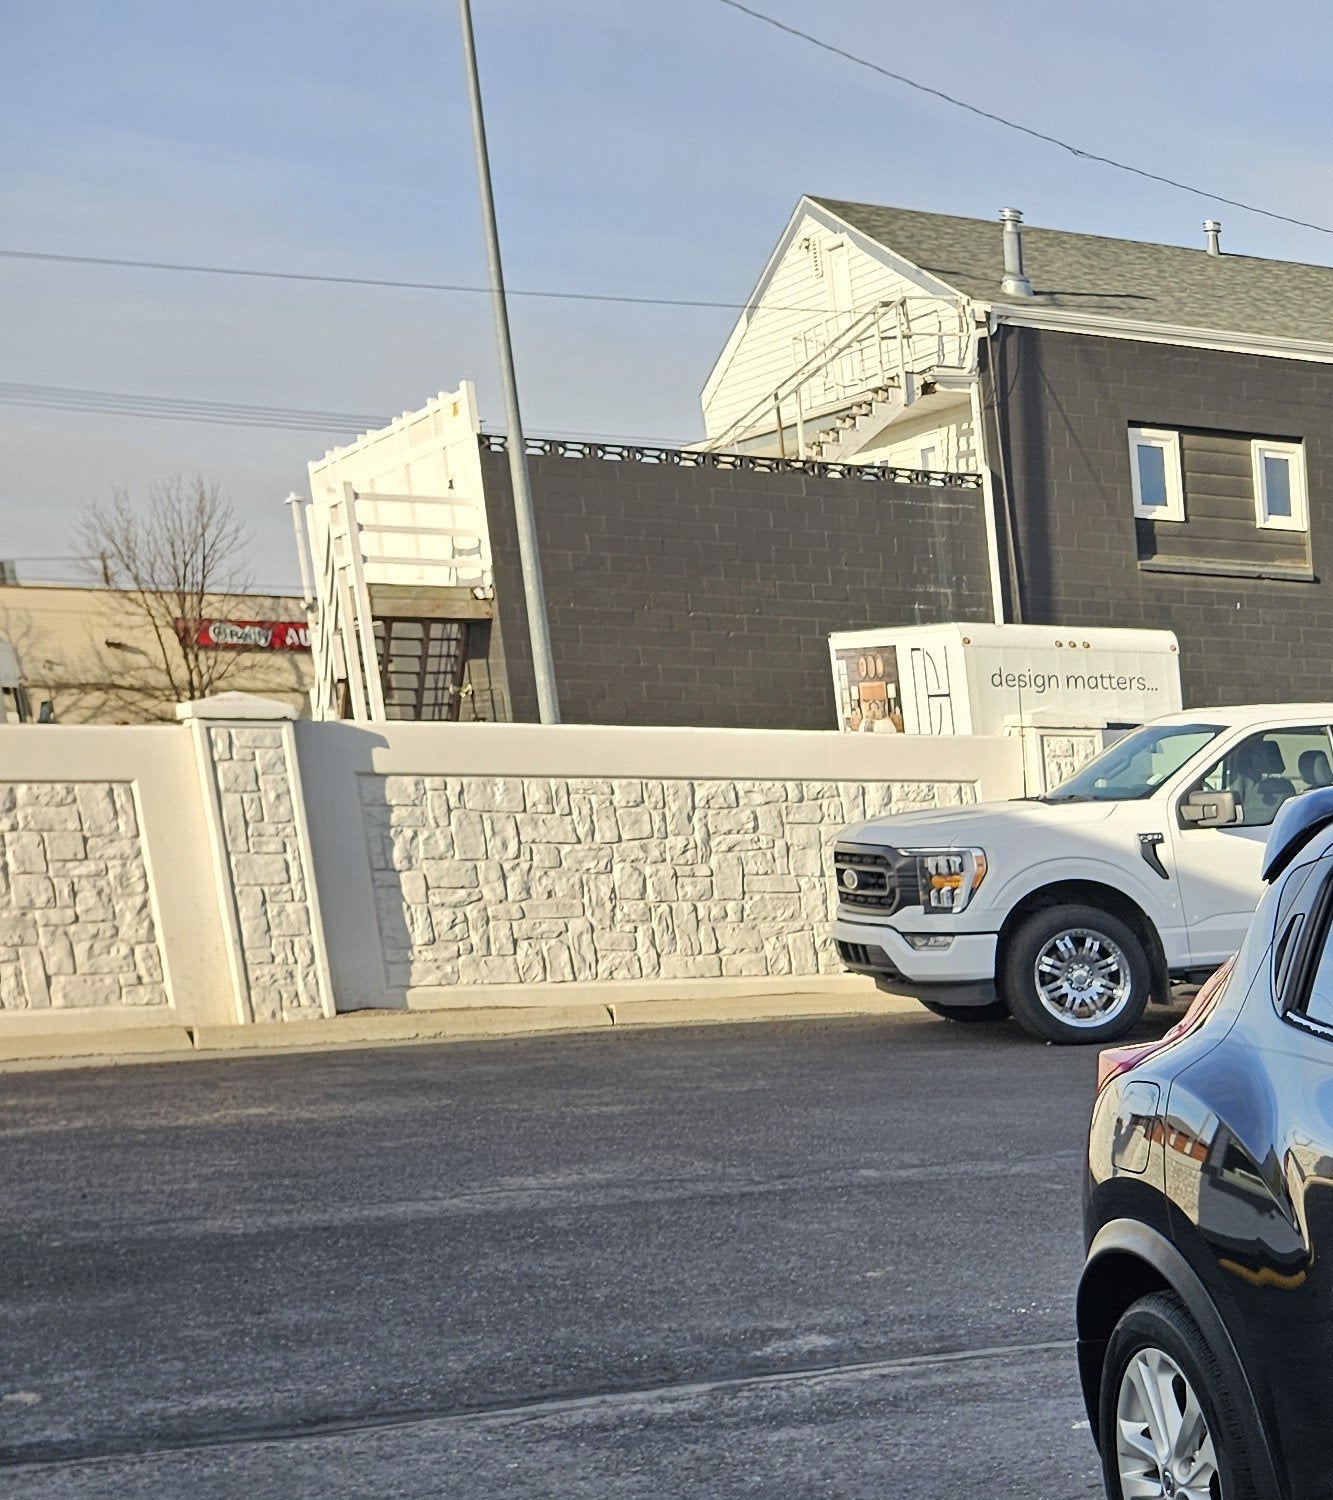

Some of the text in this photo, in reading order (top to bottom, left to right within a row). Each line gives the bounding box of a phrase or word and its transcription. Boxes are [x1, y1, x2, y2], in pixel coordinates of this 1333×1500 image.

[285, 627, 312, 647] AU
[991, 667, 1158, 693] design matters...
